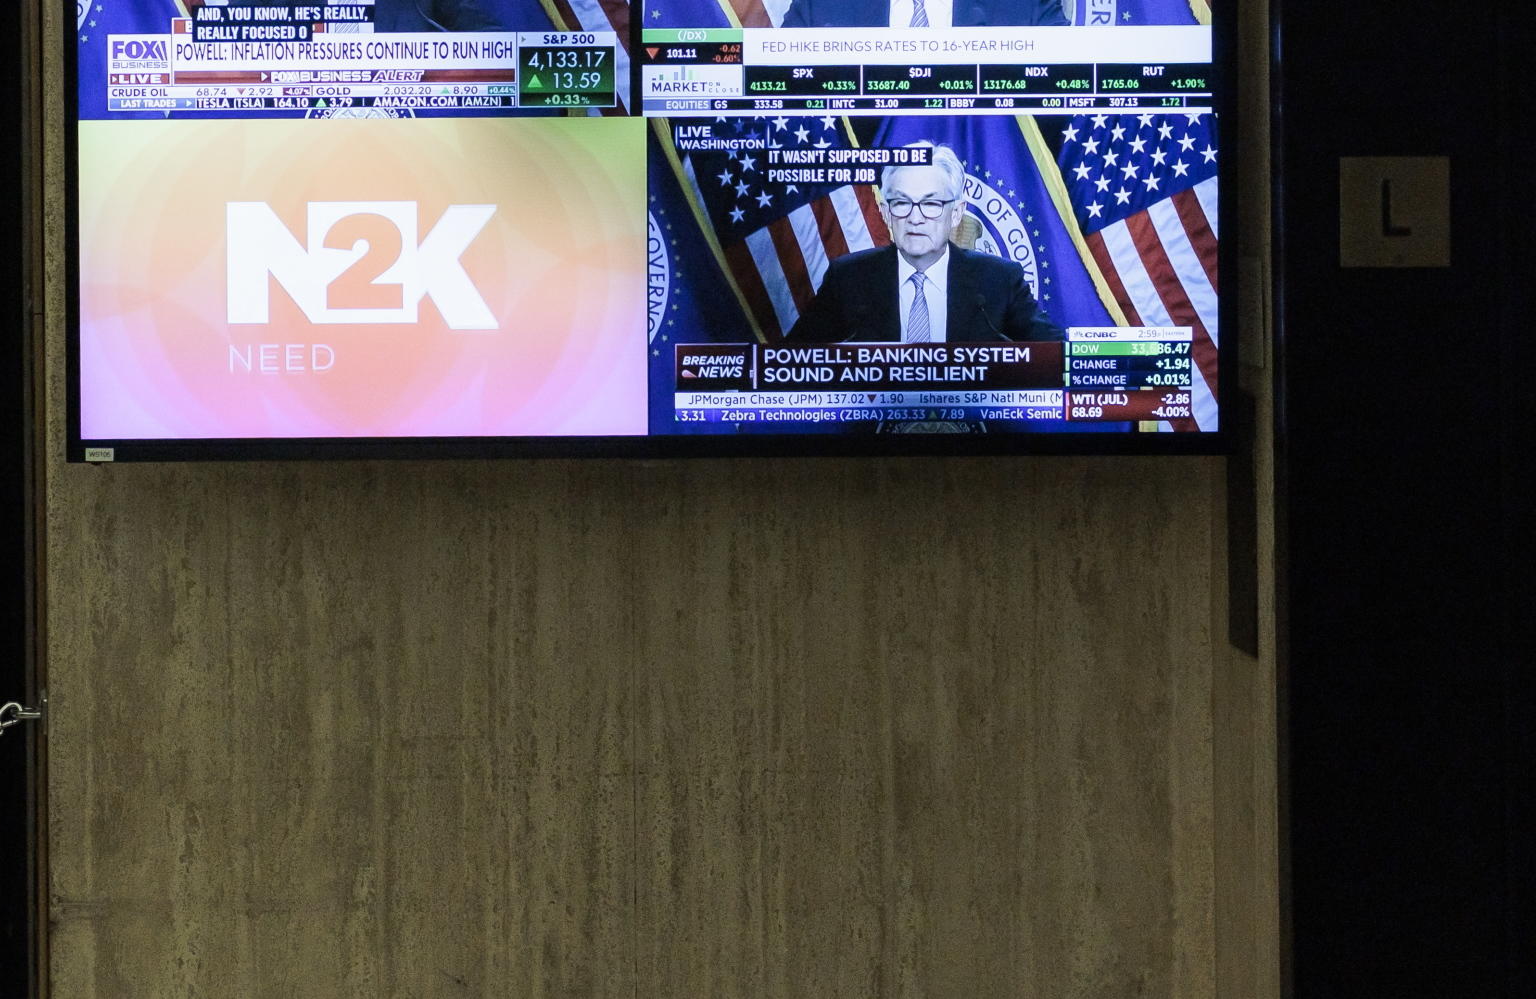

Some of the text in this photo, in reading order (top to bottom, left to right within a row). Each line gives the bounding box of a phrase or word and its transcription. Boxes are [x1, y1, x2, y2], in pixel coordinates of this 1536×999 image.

[197, 6, 368, 22] AND, YOU KNOW, HE'S REALLY,
[197, 26, 238, 40] REALLY
[242, 26, 296, 40] FOCUSED
[298, 26, 308, 39] O
[543, 34, 595, 45] S&P 500
[112, 40, 162, 61] FOX
[177, 40, 513, 61] POWELL: INFLATION PRESSURES CONTINUE TO RUN HIGH
[762, 40, 1034, 52] FED HIKE BRINGS RATES TO 16-YEAR HIGH
[666, 48, 697, 58] 101.11
[112, 61, 168, 69] BUSINESS
[528, 51, 606, 71] 4,133.17
[300, 70, 371, 82] BUSINESS
[373, 69, 424, 83] ALERT
[793, 68, 814, 78] SPX
[909, 67, 931, 78] $DJI
[1025, 67, 1048, 77] NDX
[1142, 66, 1164, 76] RUT
[119, 74, 162, 84] LIVE
[553, 72, 601, 89] 13.59
[984, 80, 1026, 89] 13176.68
[1055, 79, 1090, 89] +0.48%
[1102, 79, 1139, 89] 1765.06
[1170, 79, 1206, 89] +1.90%
[652, 81, 707, 92] MARKET
[750, 81, 787, 91] 4133.21
[822, 81, 855, 90] +0.33%
[867, 80, 910, 90] 33687.40
[939, 80, 973, 90] +0.01%
[112, 88, 146, 97] CRUDE
[150, 88, 168, 97] OIL
[196, 87, 227, 96] 68.74
[249, 87, 273, 96] 2.92
[316, 87, 351, 96] GOLD
[453, 86, 478, 95] 8.90
[120, 99, 142, 108] LAST
[144, 99, 176, 108] TRADES
[197, 98, 229, 108] TESLA
[234, 98, 264, 109] (TSLA)
[273, 98, 309, 108] 164.10
[329, 97, 352, 107] 3.79
[373, 97, 458, 107] AMAZON.COM
[461, 97, 502, 107] (AMZN)
[666, 98, 1180, 109] EQUITIES GS 333.58 0.21 INTC 31.00 1.22 BBBY 0.08 0.00 MSFT 307.13 1.72
[679, 126, 711, 137] LIVE
[680, 138, 765, 149] WASHINGTON
[768, 150, 927, 163] IT WASN'T SUPPOSED TO BE
[768, 169, 876, 182] POSSIBLE FOR JOB
[987, 198, 1013, 223] OF
[1382, 178, 1411, 236] L
[226, 200, 500, 330] N2K
[1072, 344, 1099, 353] DOW
[228, 344, 335, 374] NEED
[682, 355, 745, 366] BREAKING
[764, 347, 1030, 364] POWELL: BANKING SYSTEM
[1072, 358, 1190, 369] CHANGE +1.94
[698, 366, 743, 378] NEWS
[764, 366, 988, 382] SOUND AND RESILIENT
[1083, 375, 1127, 385] CHANGE
[1145, 373, 1190, 385] +0.01%
[688, 394, 746, 406] JPMorgan
[750, 394, 785, 404] Chase
[789, 394, 823, 405] (JPM)
[826, 394, 864, 404] 137.02
[880, 393, 904, 403] 1.90
[964, 393, 987, 403] S&P
[991, 393, 1014, 403] Natl
[1019, 393, 1046, 403] Muni
[1072, 393, 1190, 406] WTI (JUL) -2.86
[681, 408, 1062, 423] 3.31 Zebra Technologies (ZBRA) 263.33 7.89 VanEck Semic
[1072, 406, 1190, 418] 68.69 -4.00%
